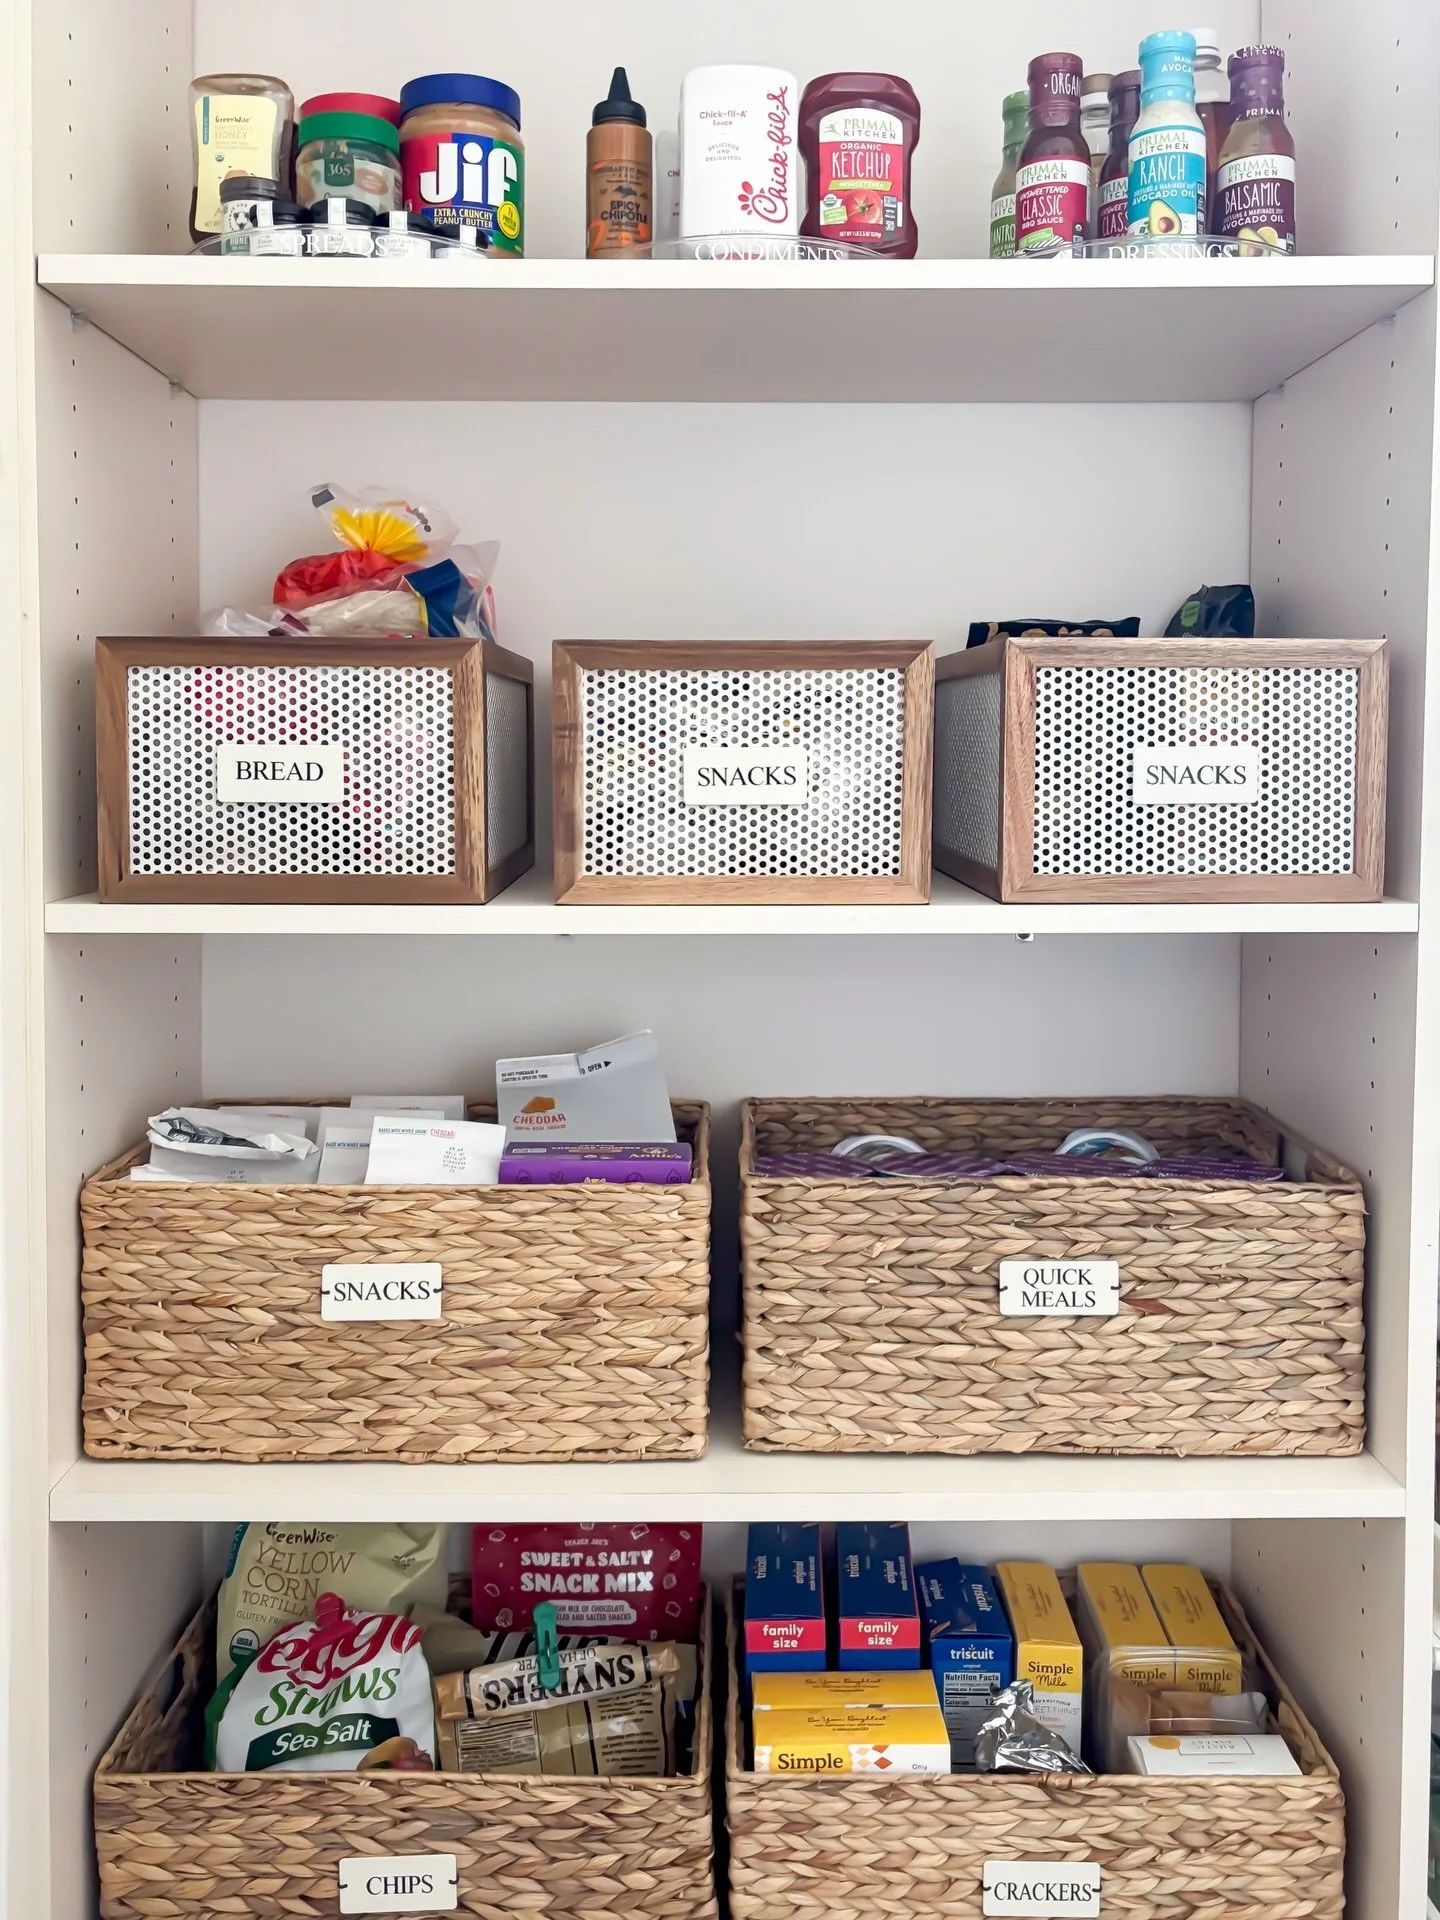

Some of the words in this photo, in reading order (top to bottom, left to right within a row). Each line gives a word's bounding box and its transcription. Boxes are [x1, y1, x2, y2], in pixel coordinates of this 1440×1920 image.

[699, 110, 746, 120] Chick-fil-A
[1246, 107, 1283, 118] PRIMA
[843, 118, 896, 132] PRIMAL
[215, 131, 248, 139] HONEY
[843, 129, 896, 140] KITCHEN
[1139, 132, 1187, 149] PRIMAL
[752, 86, 792, 224] Chick-fil-A
[840, 143, 882, 151] ORGANIC
[1139, 143, 1189, 156] KITCHEN
[328, 163, 352, 177] 365
[832, 151, 891, 179] KETCHUP
[1021, 162, 1067, 180] PRIMAL
[1140, 156, 1185, 187] RANCH
[1229, 158, 1278, 176] PRIMAL
[419, 142, 518, 207] Jif
[1021, 173, 1068, 186] KITCHEN
[1229, 169, 1278, 183] KITCHEN
[1020, 186, 1070, 202] UNSWEETENED
[1133, 190, 1177, 206] AVOCADO
[1181, 189, 1196, 198] OIL
[1225, 182, 1281, 215] BALSAMIC
[434, 208, 457, 217] EXTRA
[459, 208, 493, 220] CRUNCHY
[610, 200, 640, 211] SPICY
[1022, 195, 1063, 220] CLASSIC
[434, 217, 463, 225] PEANUT
[466, 217, 493, 228] BUTTER
[601, 211, 648, 223] CHIPOTLE
[1022, 221, 1036, 230] BBQ
[1037, 216, 1064, 225] SAUCE
[1222, 214, 1267, 232] AVOCADO
[1270, 212, 1285, 223] OIL
[280, 232, 388, 258] SPREADS
[695, 242, 843, 260] CONDIMENTS
[1108, 243, 1235, 260] DRESSINGS
[235, 761, 323, 781] BREAD
[698, 766, 797, 786] SNACKS
[1146, 765, 1246, 785] SNACKS
[587, 1063, 602, 1073] OPEN
[513, 1113, 567, 1124] CHEDDAR
[1023, 1268, 1093, 1289] QUICK
[334, 1281, 430, 1301] SNACKS
[1021, 1290, 1096, 1307] MEALS
[265, 1523, 336, 1545] GreenWise
[256, 1540, 356, 1575] YELLOW
[521, 1552, 584, 1568] SWEET
[585, 1555, 596, 1567] &
[597, 1549, 653, 1567] SALTY
[755, 1556, 767, 1579] triscuit
[793, 1561, 806, 1583] original
[847, 1555, 860, 1578] triscuit
[883, 1560, 898, 1584] original
[247, 1566, 321, 1601] CORN
[520, 1572, 600, 1593] SNACK
[604, 1571, 654, 1593] MIX
[242, 1590, 309, 1616] TORTILLA
[971, 1583, 993, 1612] triscuit
[236, 1610, 267, 1623] GLUTEN
[591, 1604, 625, 1612] CHOCOLATE
[571, 1613, 584, 1621] AND
[586, 1613, 607, 1621] SALTED
[762, 1624, 804, 1639] family
[858, 1621, 899, 1636] family
[236, 1636, 253, 1647] USDA
[773, 1637, 798, 1648] size
[867, 1634, 893, 1645] size
[950, 1646, 994, 1660] triscuit
[945, 1673, 977, 1681] Nutrition
[979, 1673, 999, 1681] Facts
[1027, 1661, 1073, 1676] Simple
[1120, 1666, 1167, 1682] Simple
[1187, 1667, 1233, 1682] Simple
[1036, 1674, 1068, 1687] Mills
[255, 1667, 401, 1726] Straws
[945, 1698, 970, 1706] Calories
[271, 1733, 319, 1757] Sea
[323, 1719, 372, 1746] Salt
[778, 1753, 844, 1772] Simple
[912, 1763, 928, 1771] Only
[366, 1874, 433, 1895] CHIPS
[994, 1881, 1092, 1901] CRACKERS
